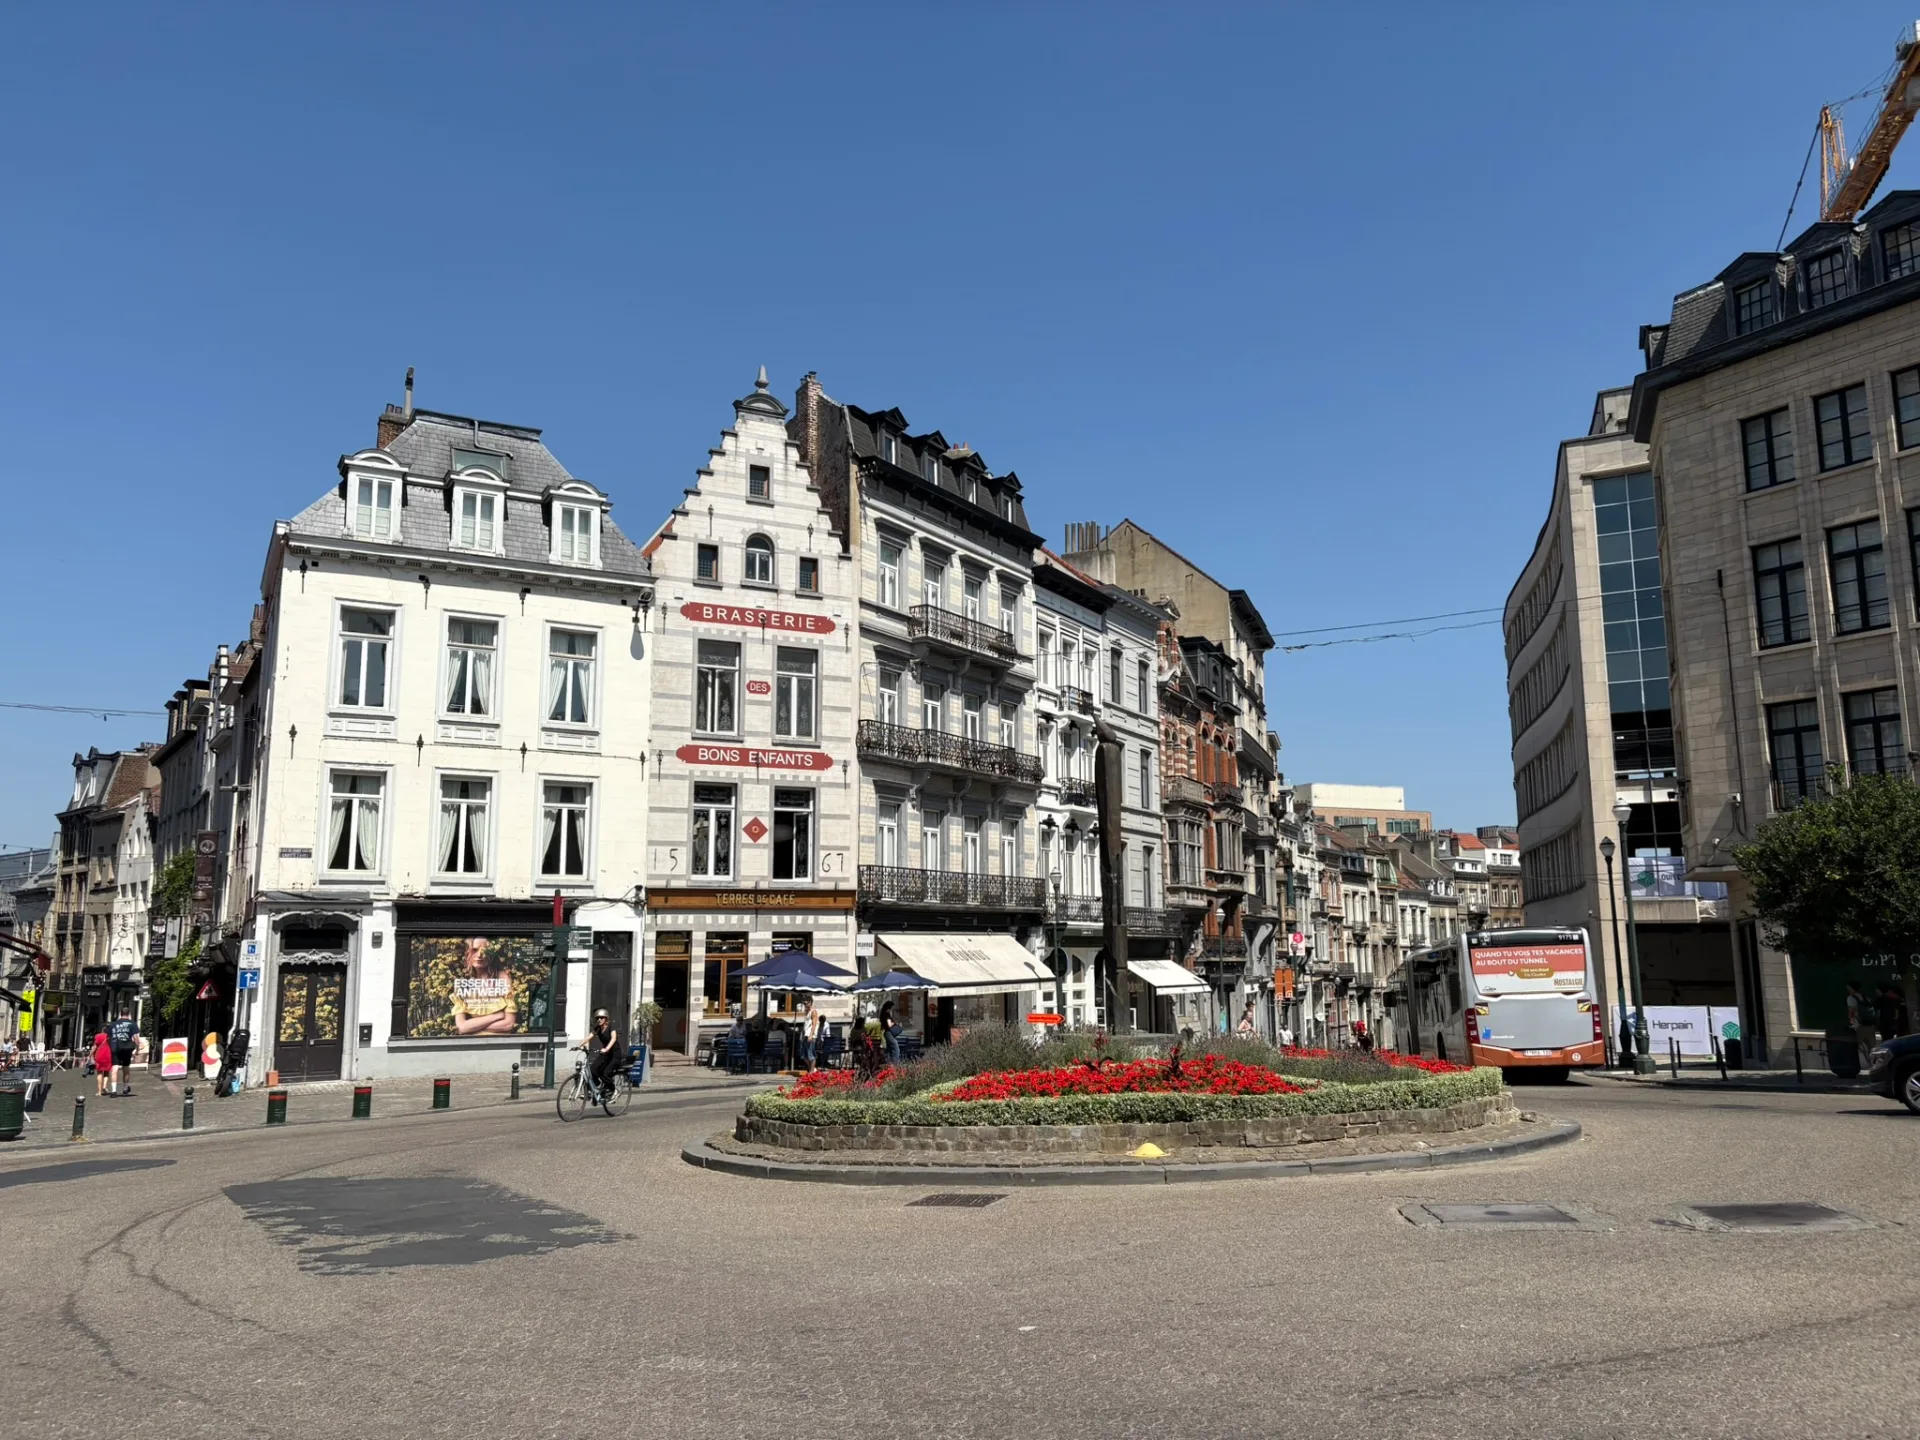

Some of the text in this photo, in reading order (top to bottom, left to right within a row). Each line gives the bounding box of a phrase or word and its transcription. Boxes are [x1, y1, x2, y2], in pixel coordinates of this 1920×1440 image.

[703, 606, 815, 629] BRASSERIE
[750, 683, 768, 692] DES
[698, 748, 813, 766] BONS ENFANTS
[716, 891, 795, 905] TERRES DE CAFÉ
[454, 978, 508, 988] ESSENTIEL
[1553, 978, 1583, 986] NOSTALGIE
[456, 987, 508, 996] ANTWERP
[1652, 1020, 1693, 1031] Herpain
